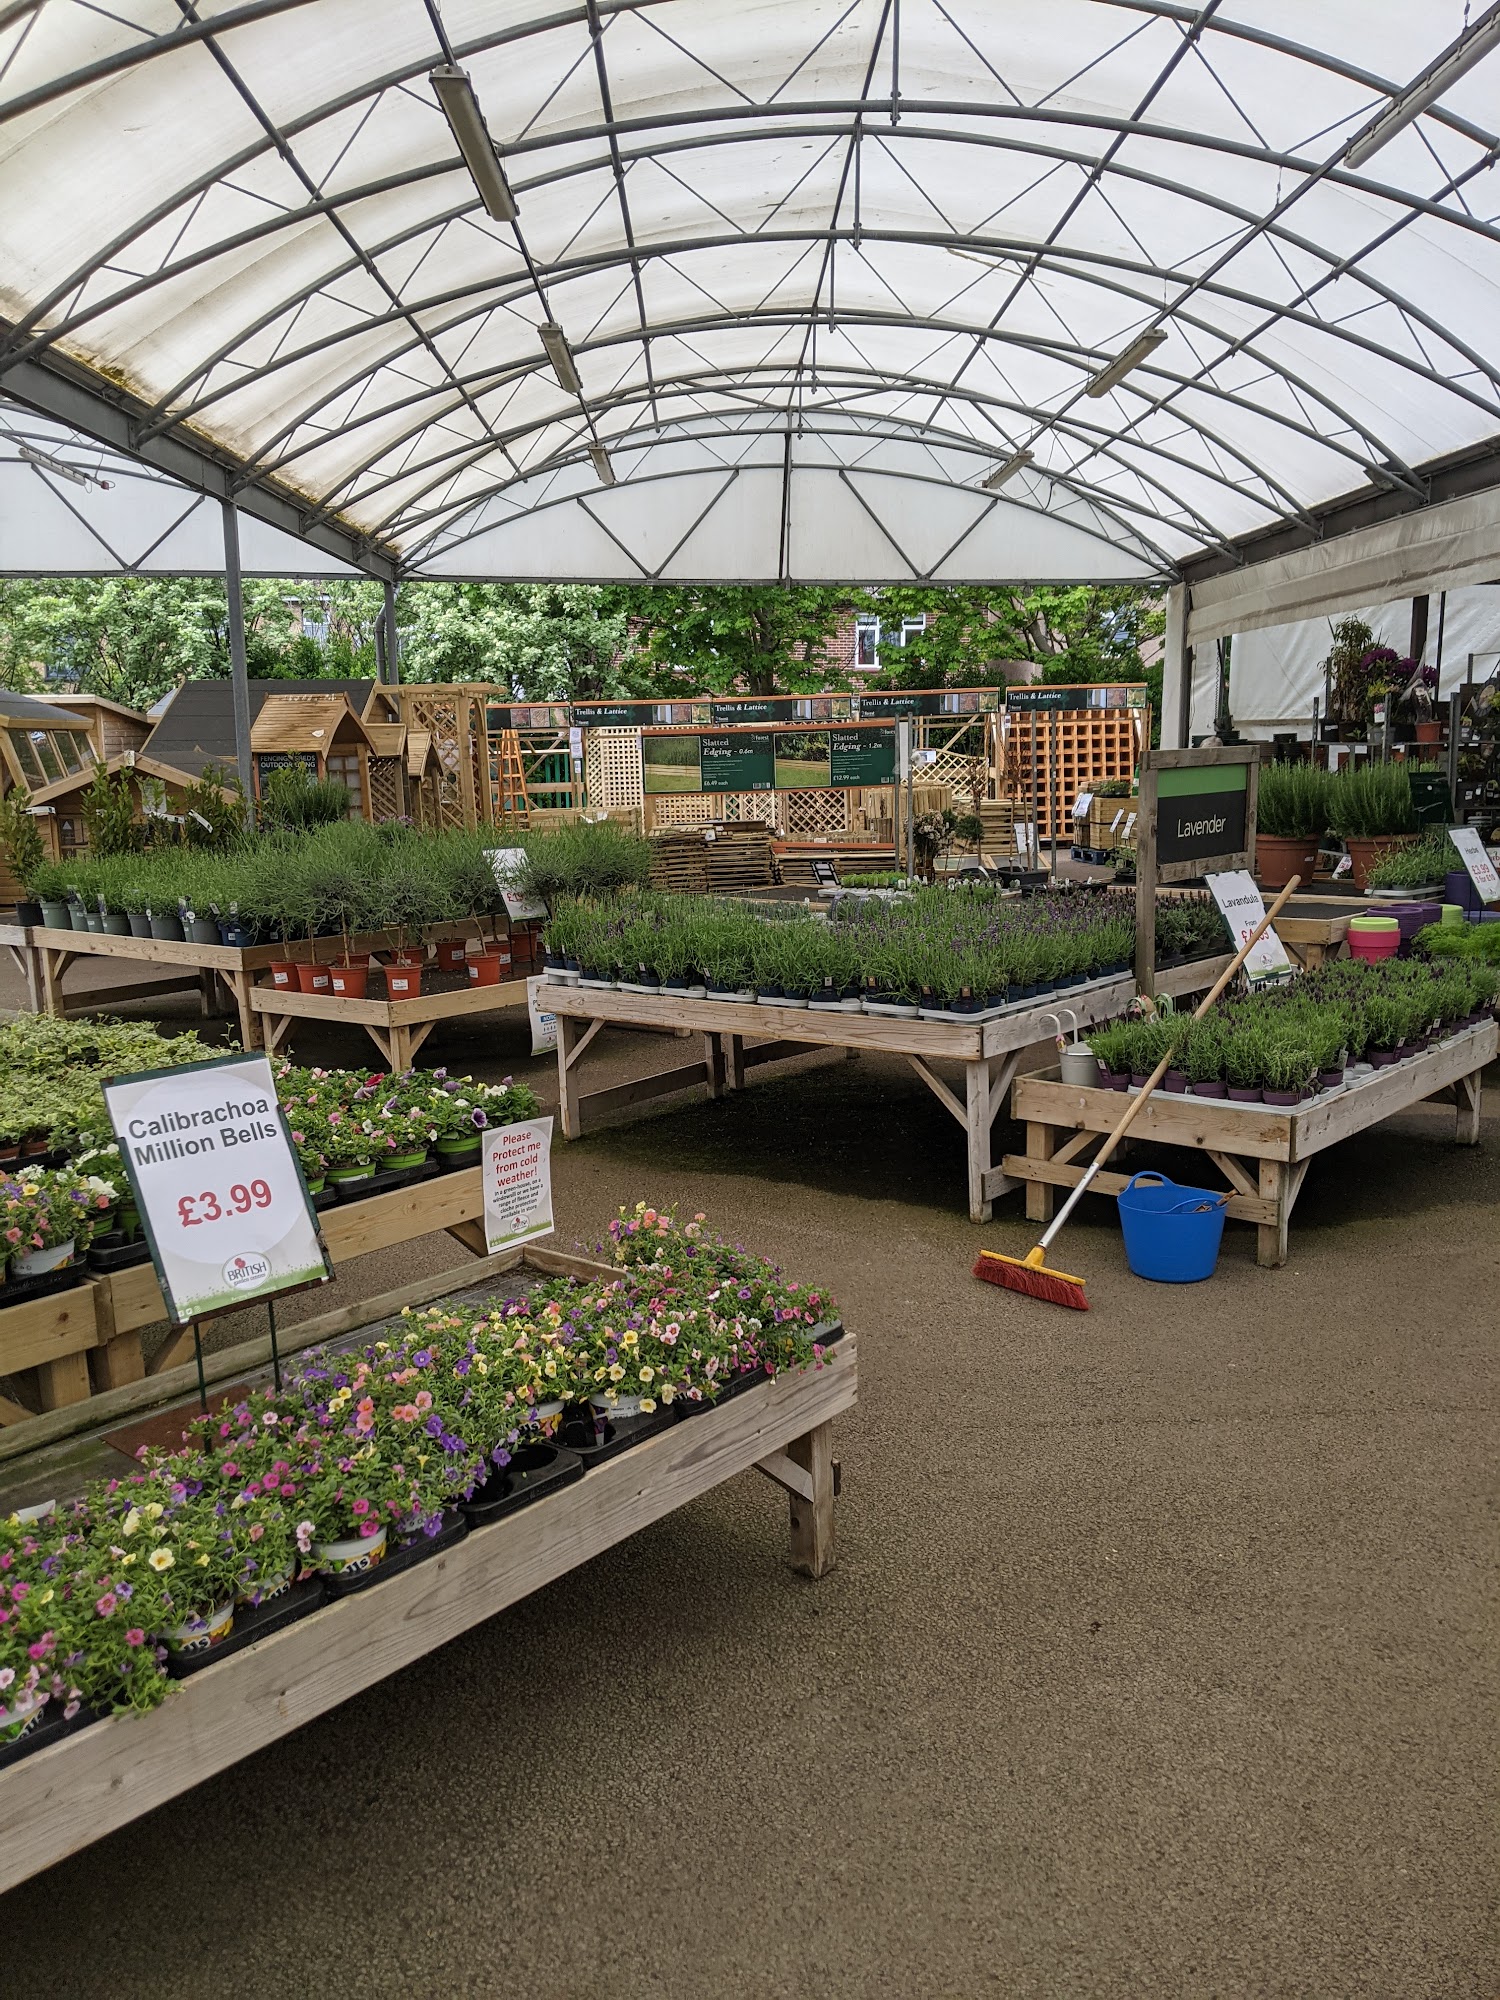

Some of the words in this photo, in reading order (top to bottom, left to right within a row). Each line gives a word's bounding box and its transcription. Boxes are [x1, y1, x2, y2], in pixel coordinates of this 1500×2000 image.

[604, 707, 627, 715] Lattice
[702, 738, 729, 746] Slatted
[832, 733, 858, 741] Slatted
[703, 747, 732, 757] Edging
[833, 742, 861, 752] Edging
[1178, 814, 1226, 837] Lavender
[1472, 863, 1489, 874] £3.99
[1222, 893, 1260, 908] Lavandula
[129, 1099, 269, 1139] Calibrachoa
[134, 1137, 215, 1166] Million
[220, 1121, 277, 1147] Bells
[503, 1132, 531, 1146] Please
[493, 1145, 525, 1162] Protect
[527, 1142, 541, 1152] me
[496, 1162, 517, 1174] from
[520, 1153, 538, 1167] cold
[497, 1166, 537, 1187] weather!
[178, 1179, 272, 1227] £3.99
[514, 1198, 537, 1209] protection
[227, 1261, 267, 1281] BRITISH
